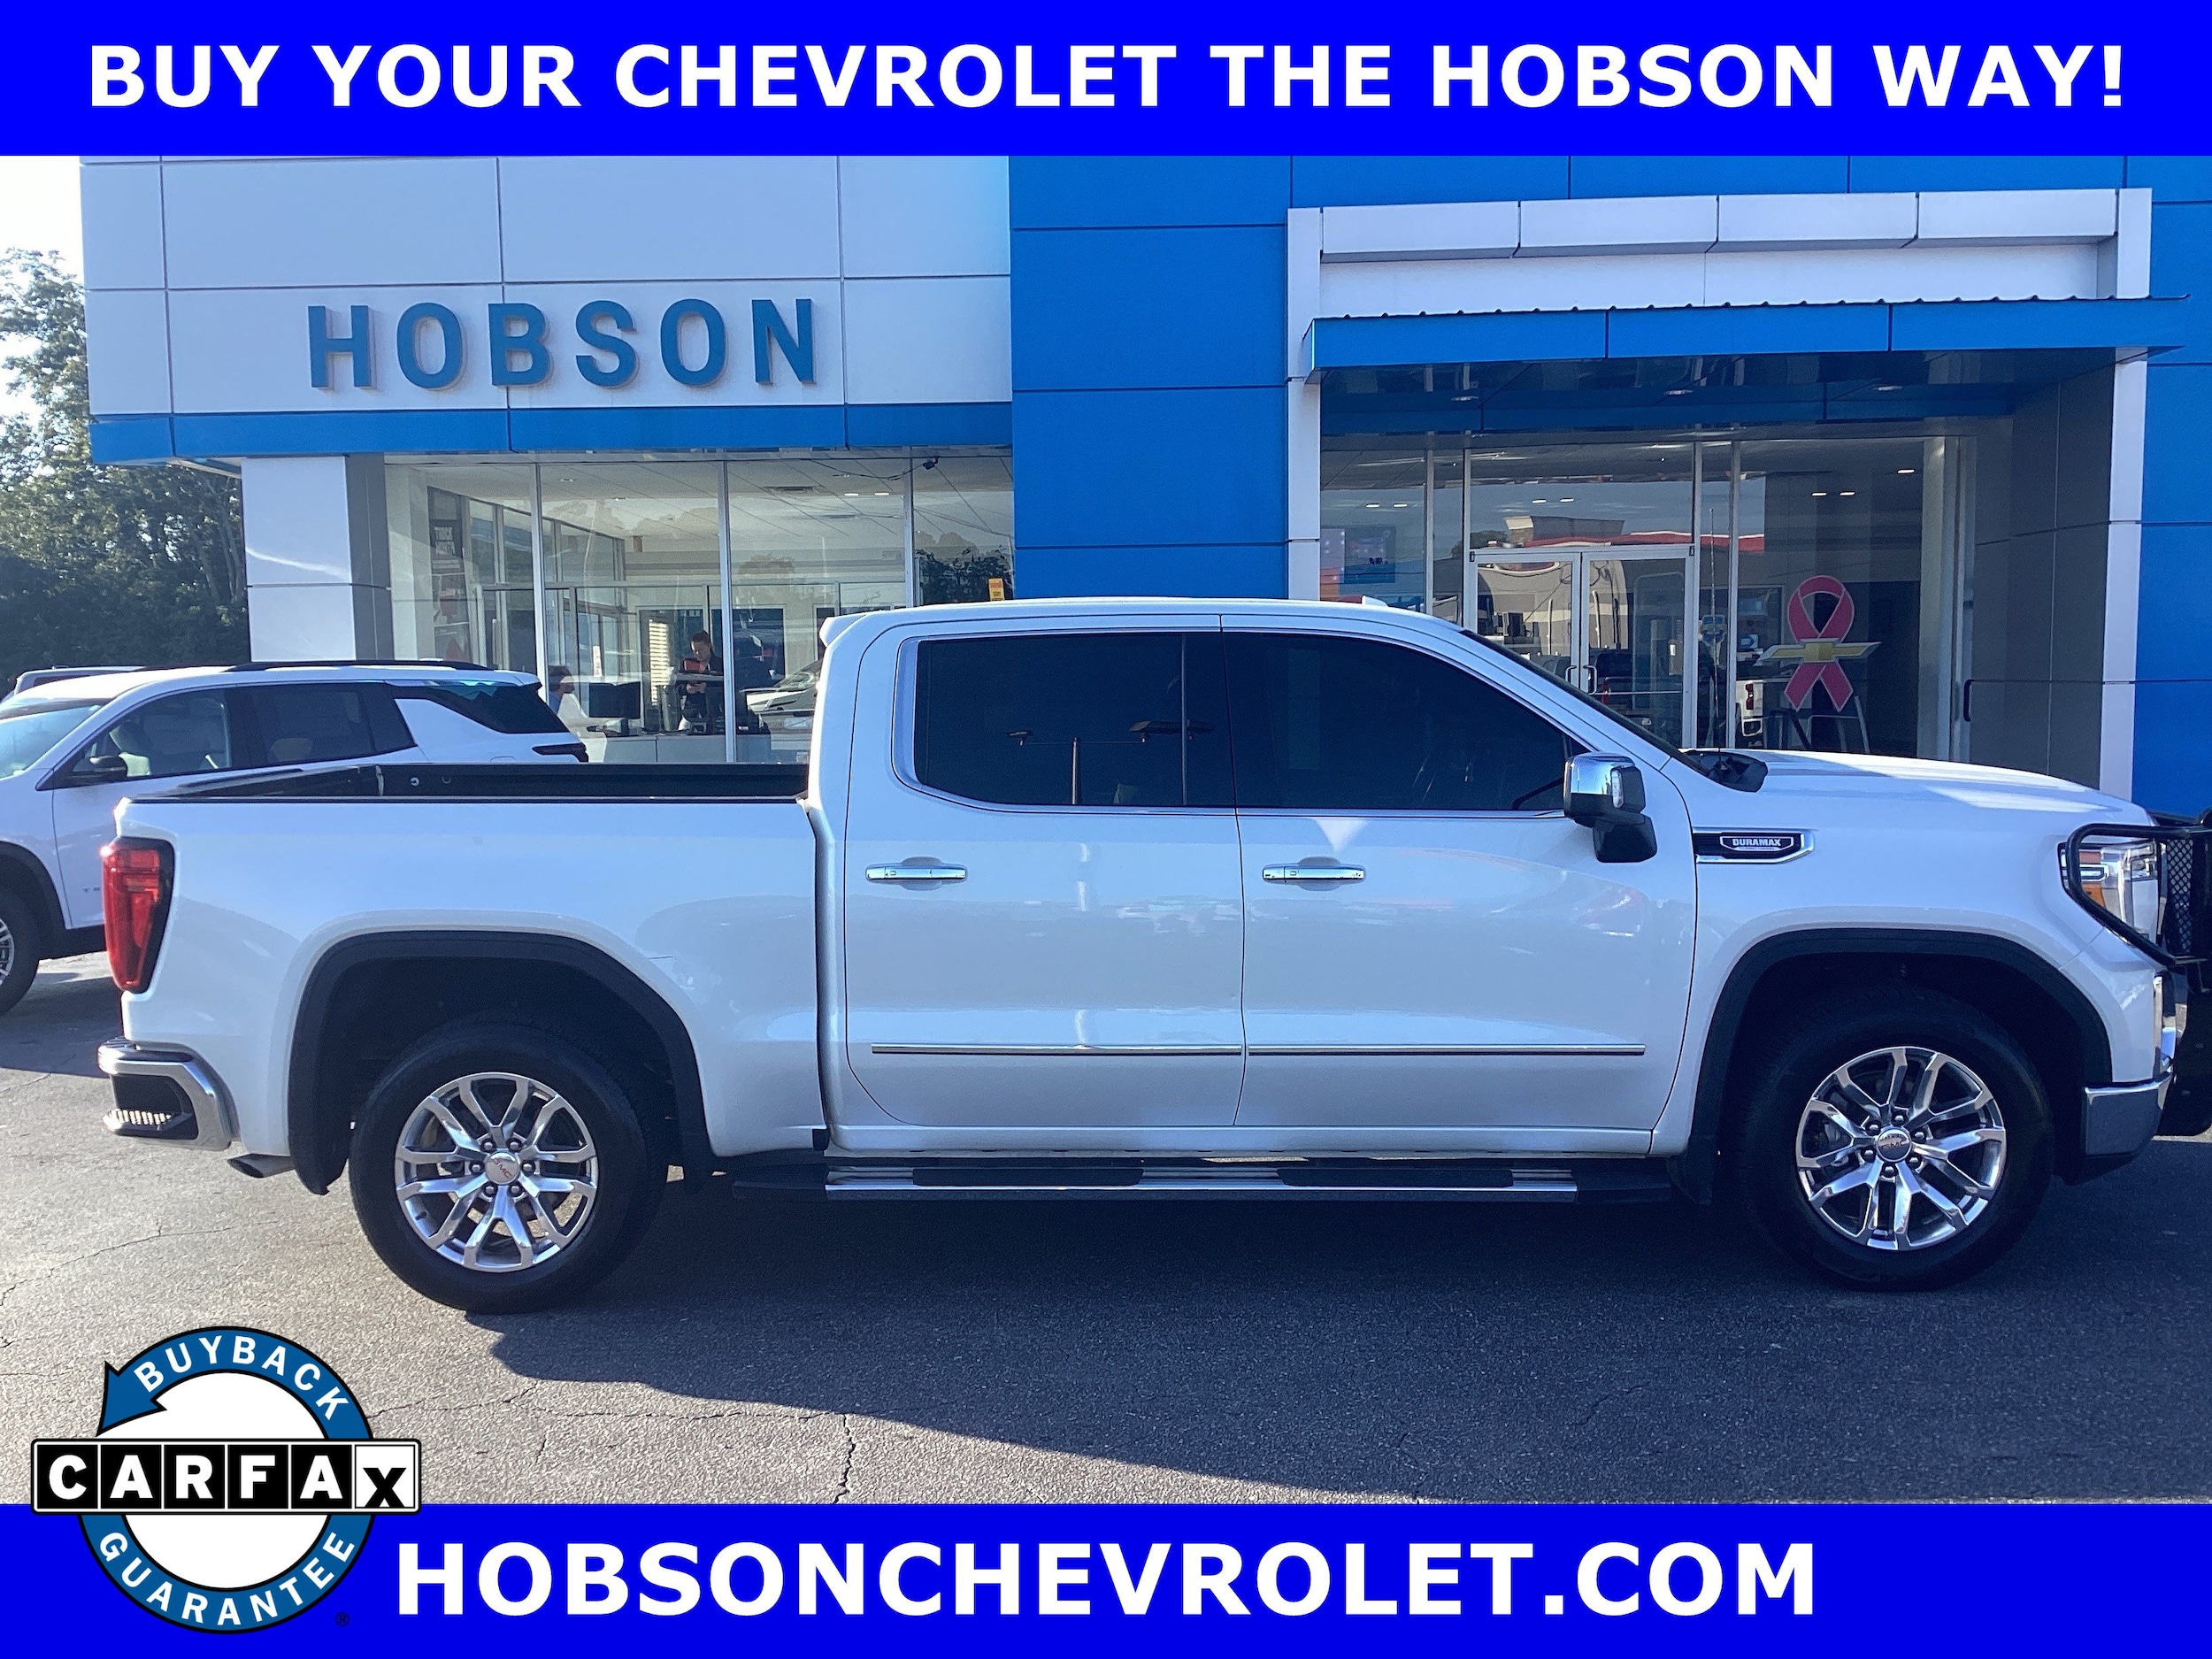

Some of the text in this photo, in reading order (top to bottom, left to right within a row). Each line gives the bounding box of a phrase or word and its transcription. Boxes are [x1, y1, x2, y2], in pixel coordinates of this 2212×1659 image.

[308, 298, 816, 389] HOBSON
[1732, 838, 1781, 847] DURAMAX
[1881, 1140, 1909, 1150] GMC
[492, 1157, 512, 1179] GMC
